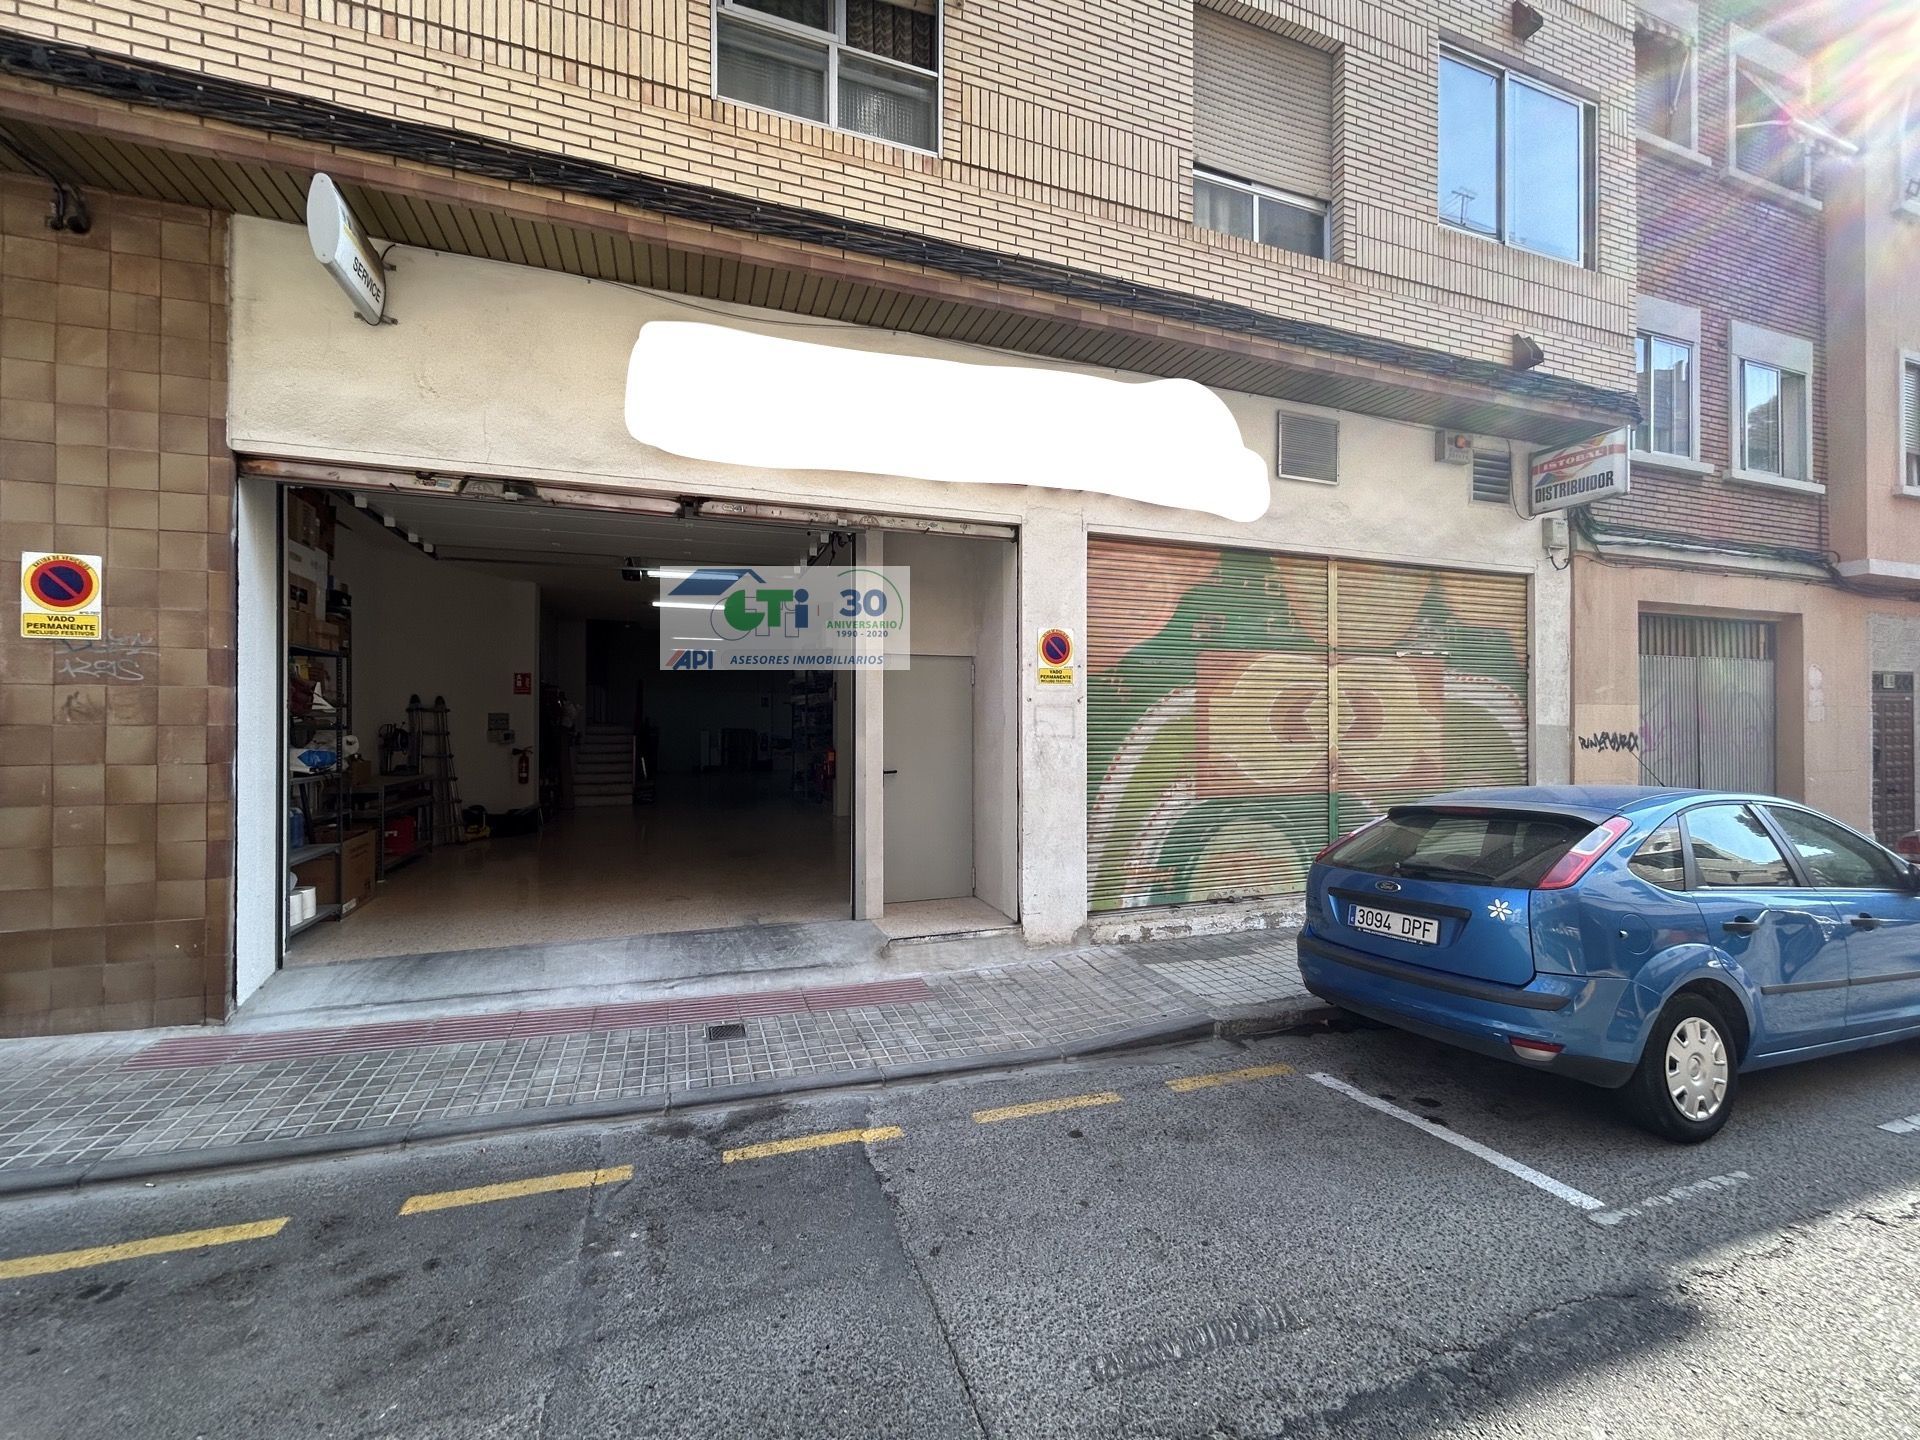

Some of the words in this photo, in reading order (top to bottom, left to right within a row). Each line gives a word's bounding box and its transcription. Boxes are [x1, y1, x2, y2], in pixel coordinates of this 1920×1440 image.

[352, 257, 381, 302] SERVICE
[1535, 470, 1614, 504] DISTRIBUIDOR
[26, 622, 96, 631] PERMANENTE
[1357, 909, 1391, 931] 3094
[1401, 917, 1433, 939] DPF
